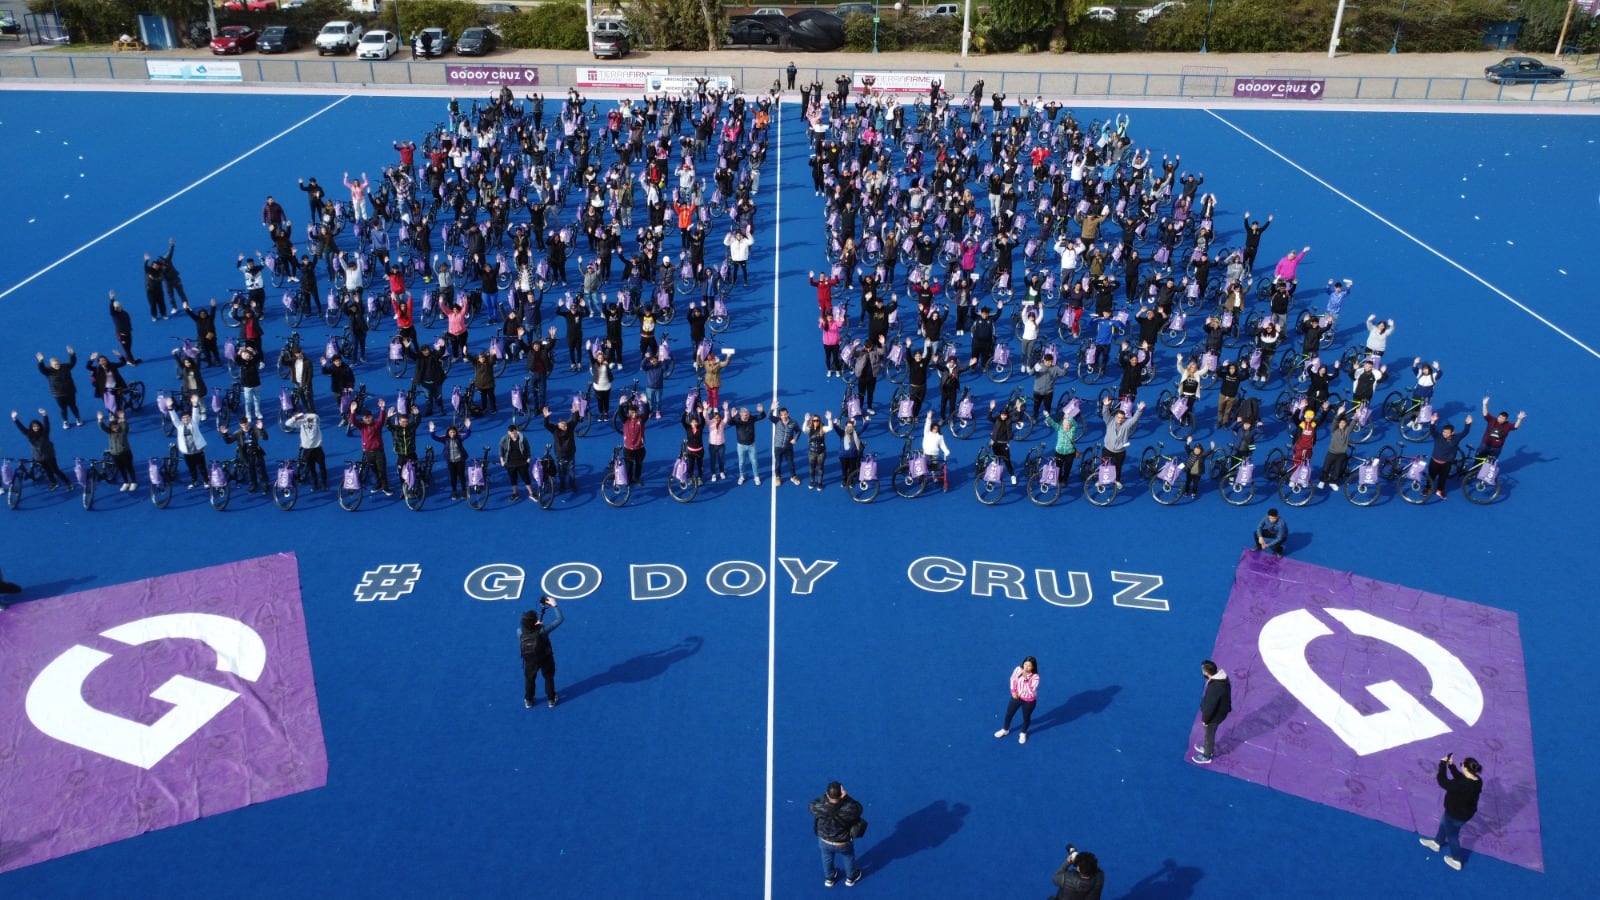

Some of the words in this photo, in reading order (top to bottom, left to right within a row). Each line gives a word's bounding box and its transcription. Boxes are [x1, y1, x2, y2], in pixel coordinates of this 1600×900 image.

[450, 70, 490, 80] GODOY
[491, 70, 521, 80] CRUZ
[1237, 83, 1277, 92] GODOY
[1277, 83, 1307, 93] CRUZ
[907, 555, 1170, 612] CRUZ
